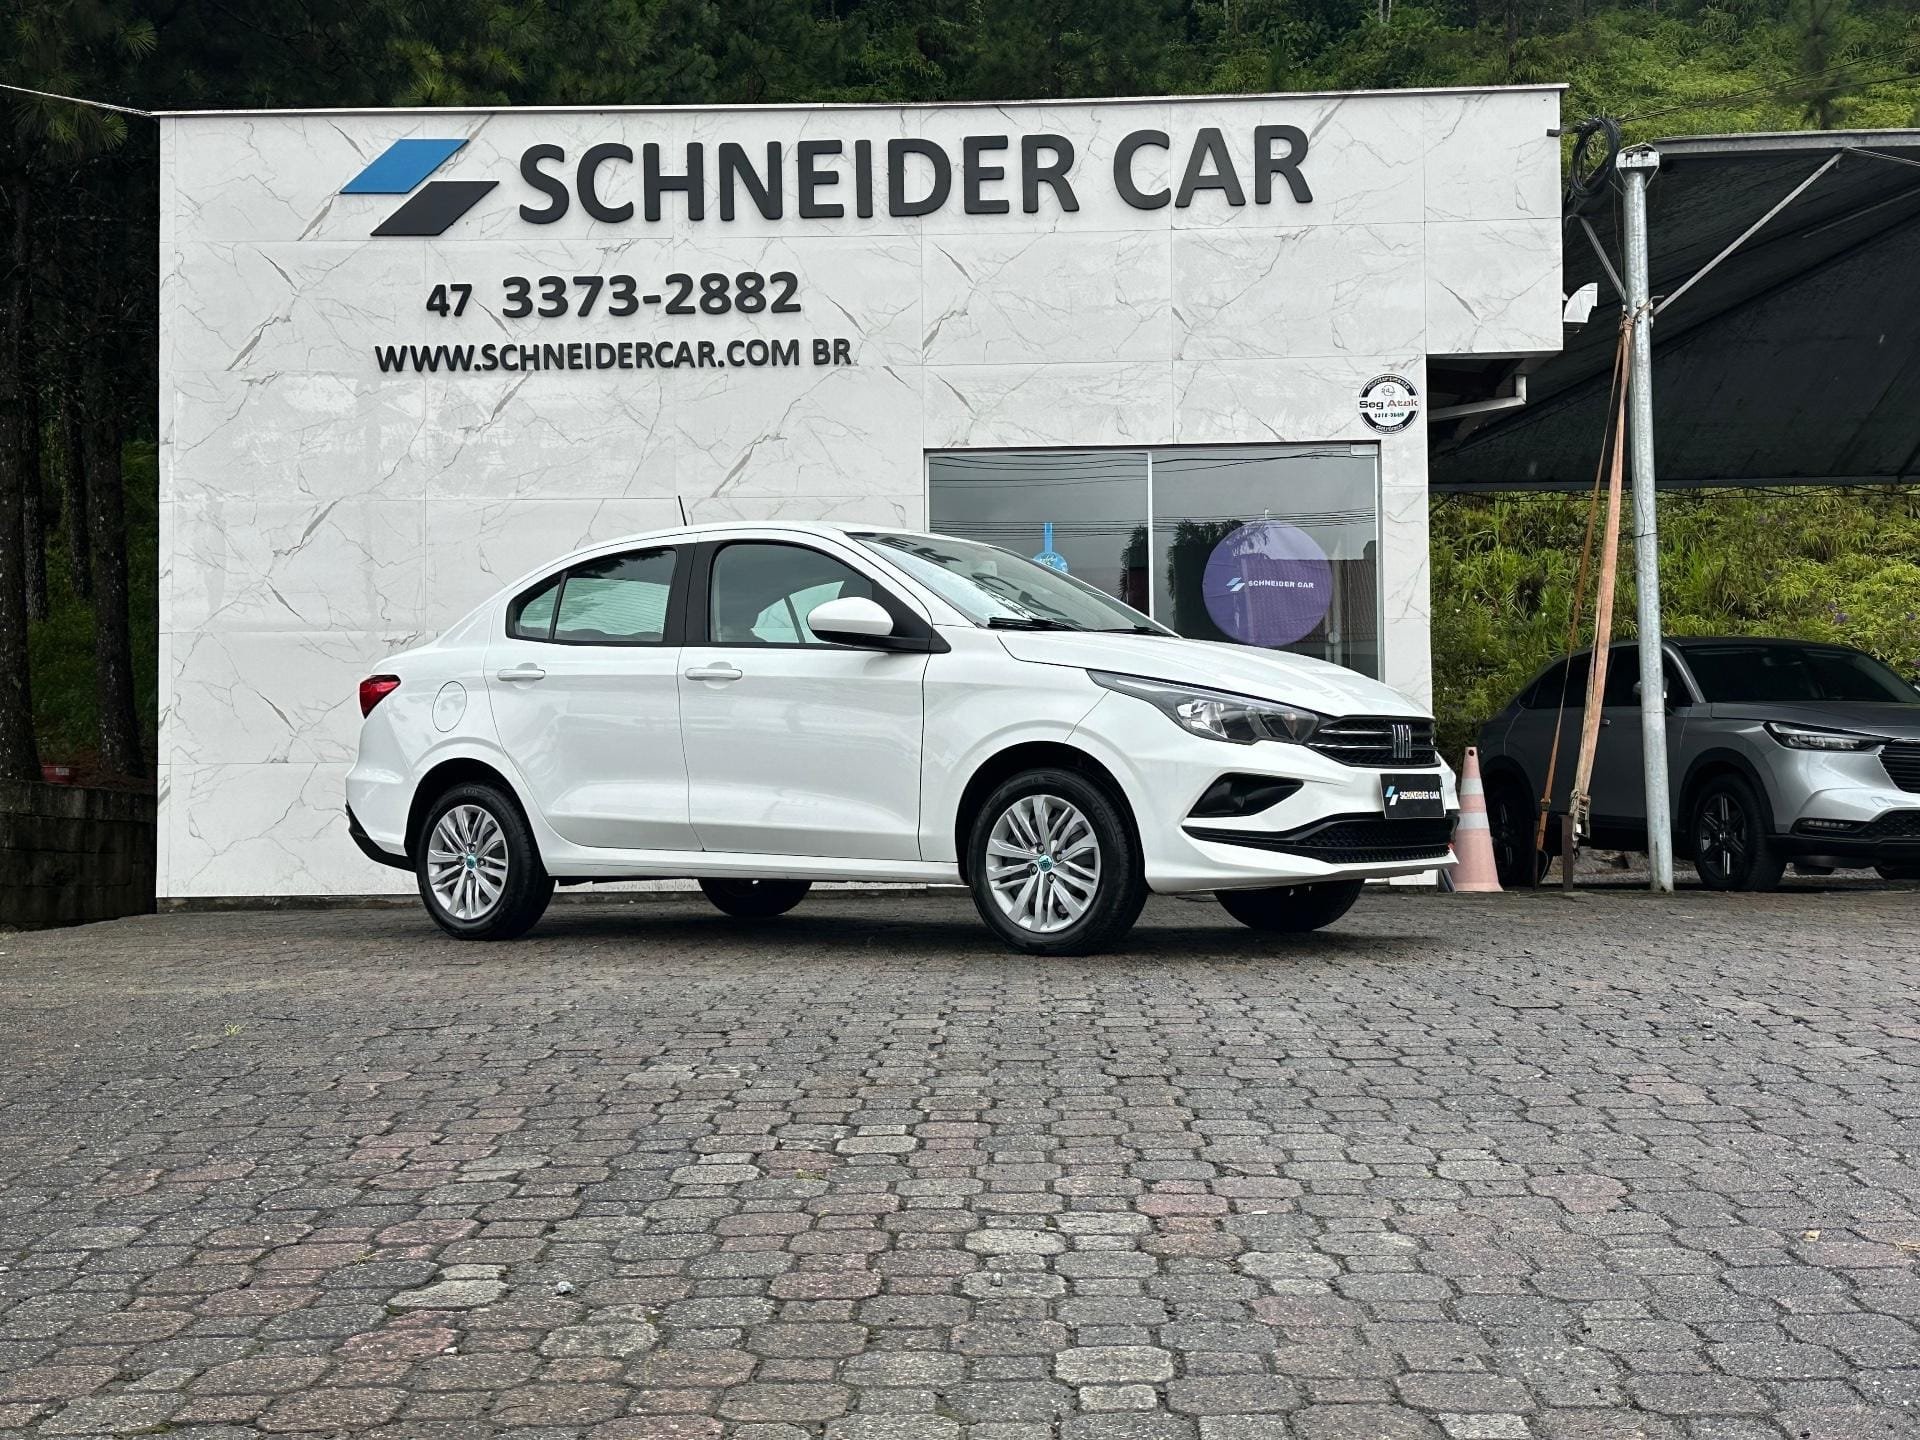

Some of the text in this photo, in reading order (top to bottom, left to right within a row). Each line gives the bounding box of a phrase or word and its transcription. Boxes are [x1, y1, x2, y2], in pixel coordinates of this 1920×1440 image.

[519, 124, 1314, 225] SCHNEIDER CAR
[425, 271, 802, 319] 47 3373-2882
[374, 338, 852, 373] WWW.SCHNEIDERCAR.COM BR
[1248, 579, 1314, 589] SCHNEIDER CAR
